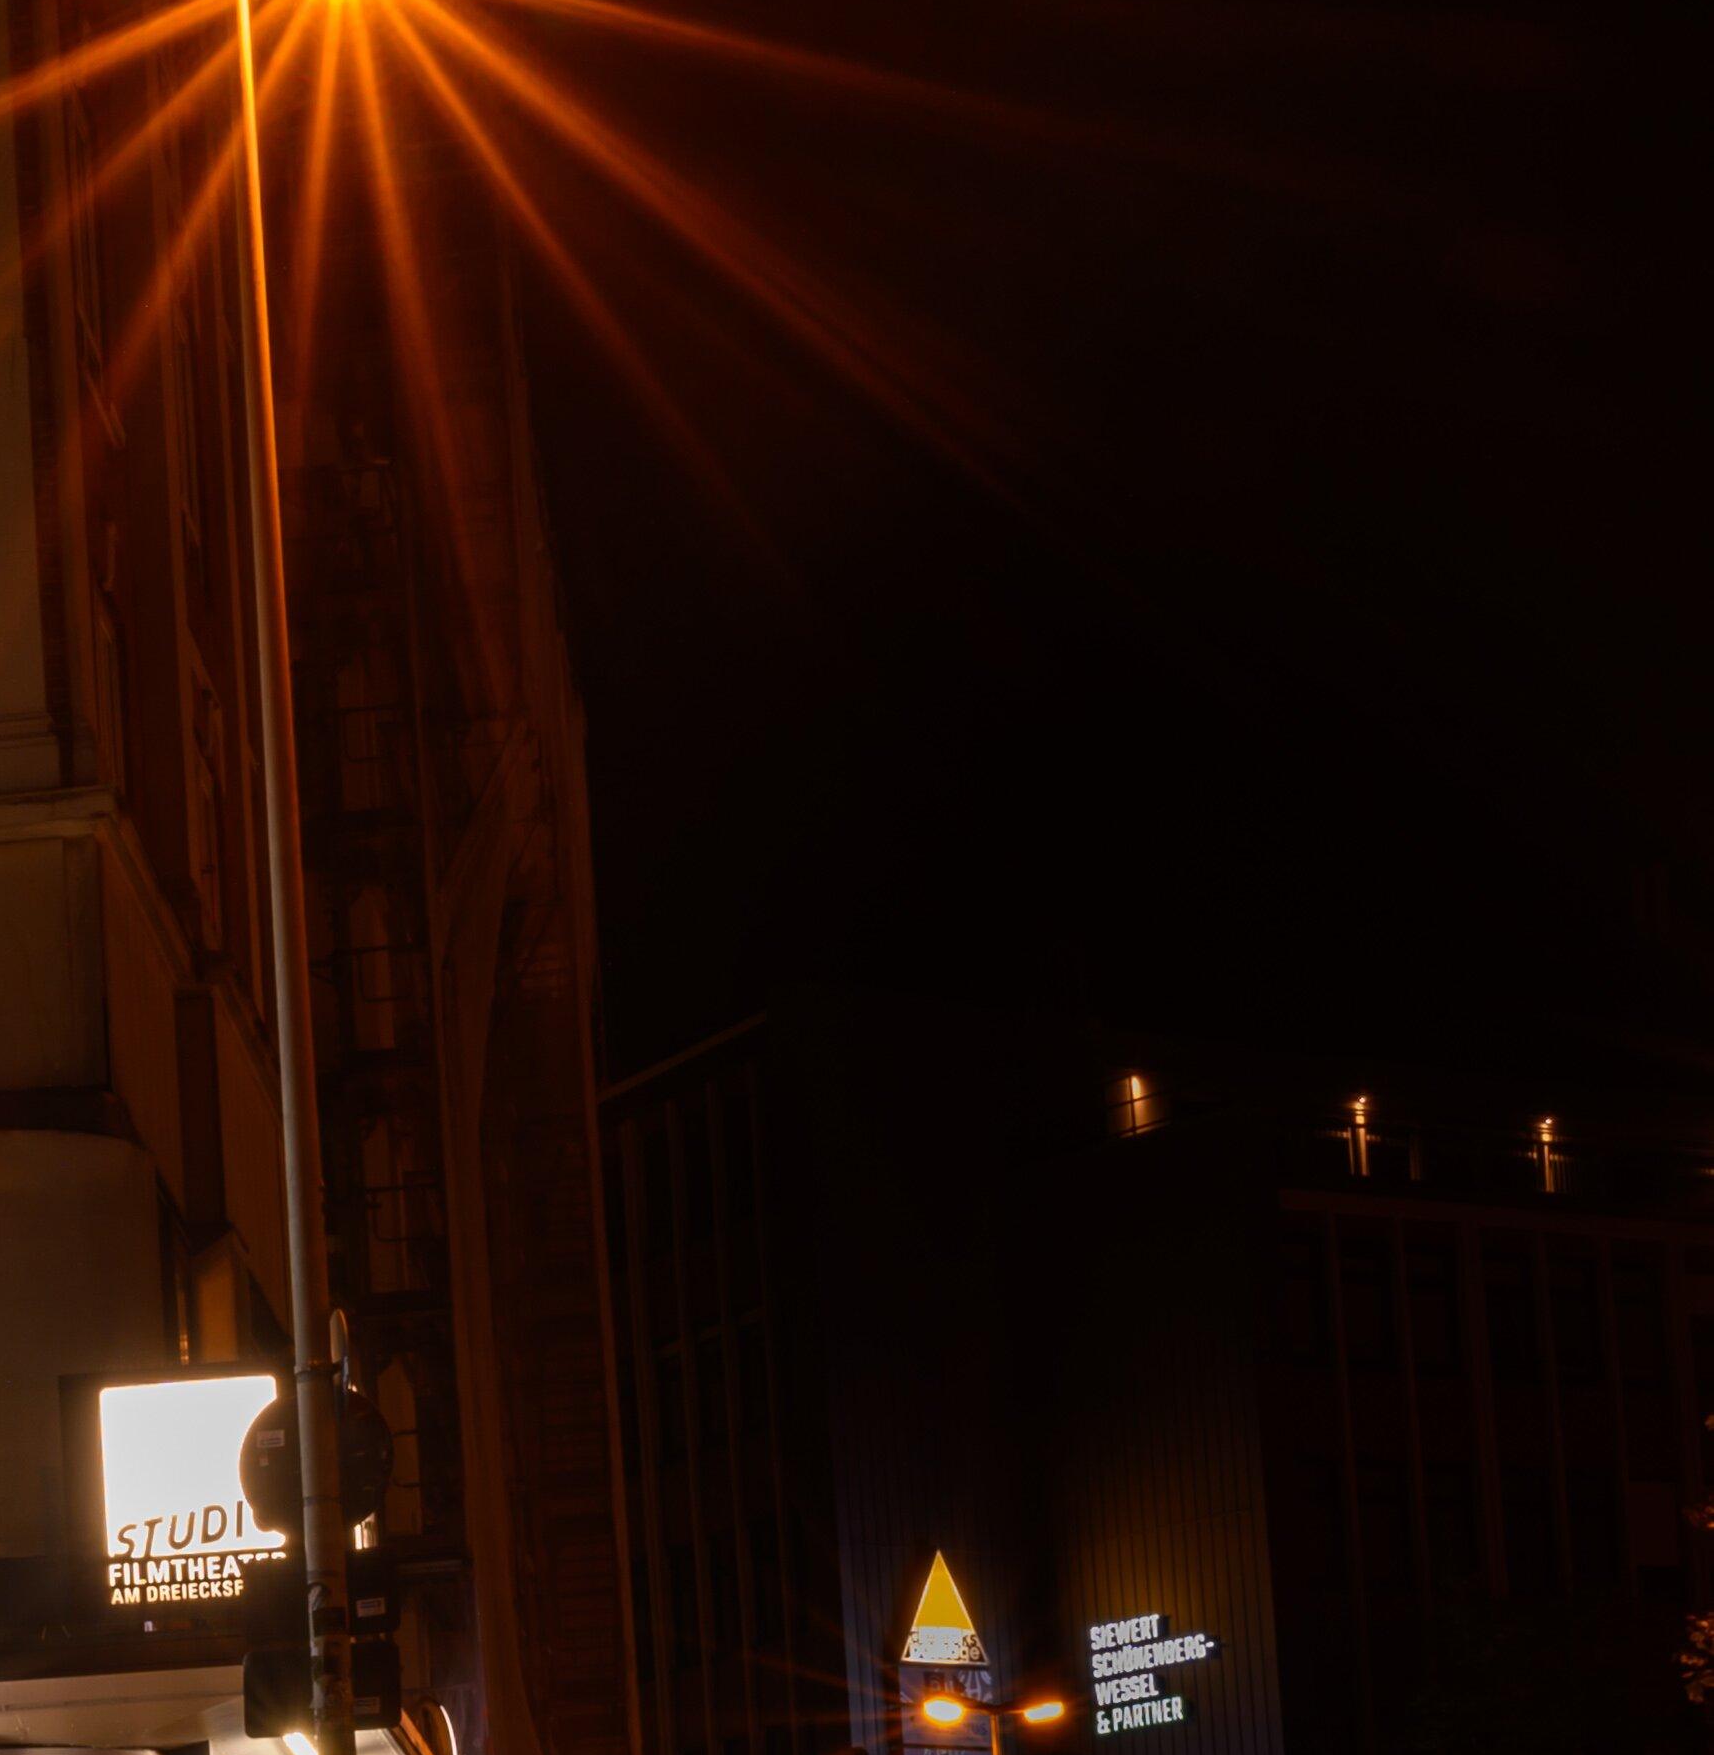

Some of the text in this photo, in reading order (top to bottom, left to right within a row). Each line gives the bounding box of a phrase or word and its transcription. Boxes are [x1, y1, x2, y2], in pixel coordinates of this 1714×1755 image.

[113, 1499, 244, 1560] STUDI
[108, 1550, 287, 1588] FILMTHEA
[110, 1587, 141, 1606] AM
[1089, 1613, 1160, 1651] SIEWERT
[1094, 1672, 1160, 1707] WESSEL
[1096, 1695, 1184, 1735] & PARTNER
